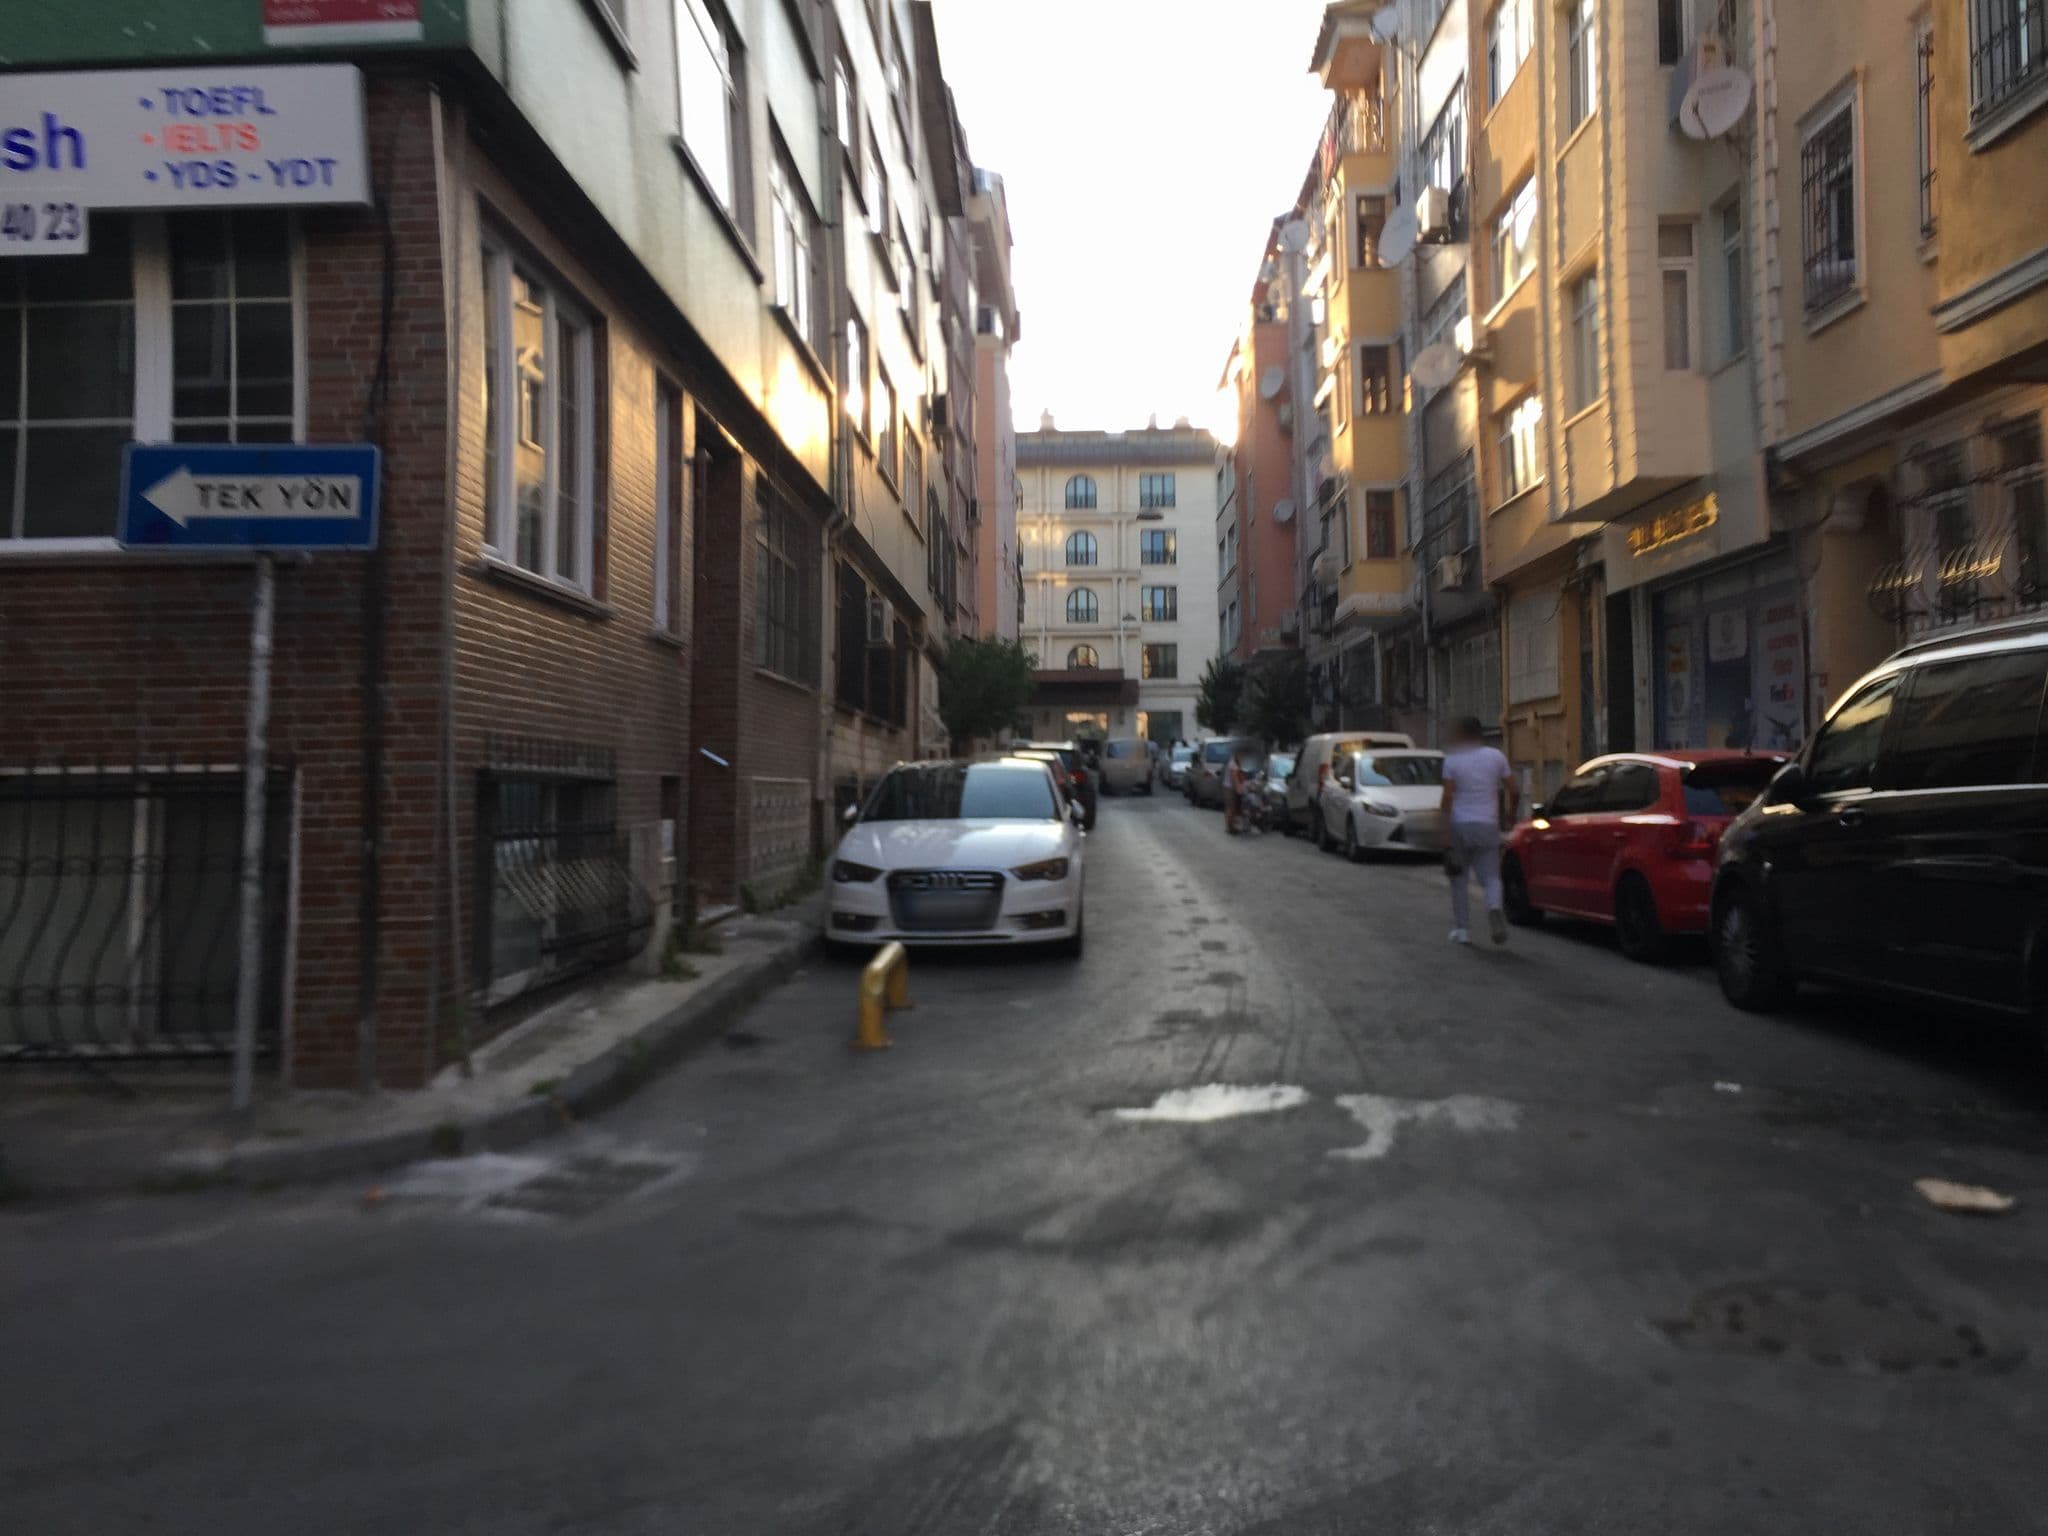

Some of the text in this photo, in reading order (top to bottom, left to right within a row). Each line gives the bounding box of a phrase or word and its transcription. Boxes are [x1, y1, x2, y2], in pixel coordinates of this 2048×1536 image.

[160, 87, 276, 116] TOEFL
[0, 111, 87, 171] sh
[164, 123, 262, 152] IELTS
[164, 159, 237, 188] YDS
[266, 158, 338, 187] YDT
[45, 202, 81, 240] 23
[195, 477, 351, 510] TEK YÖN
